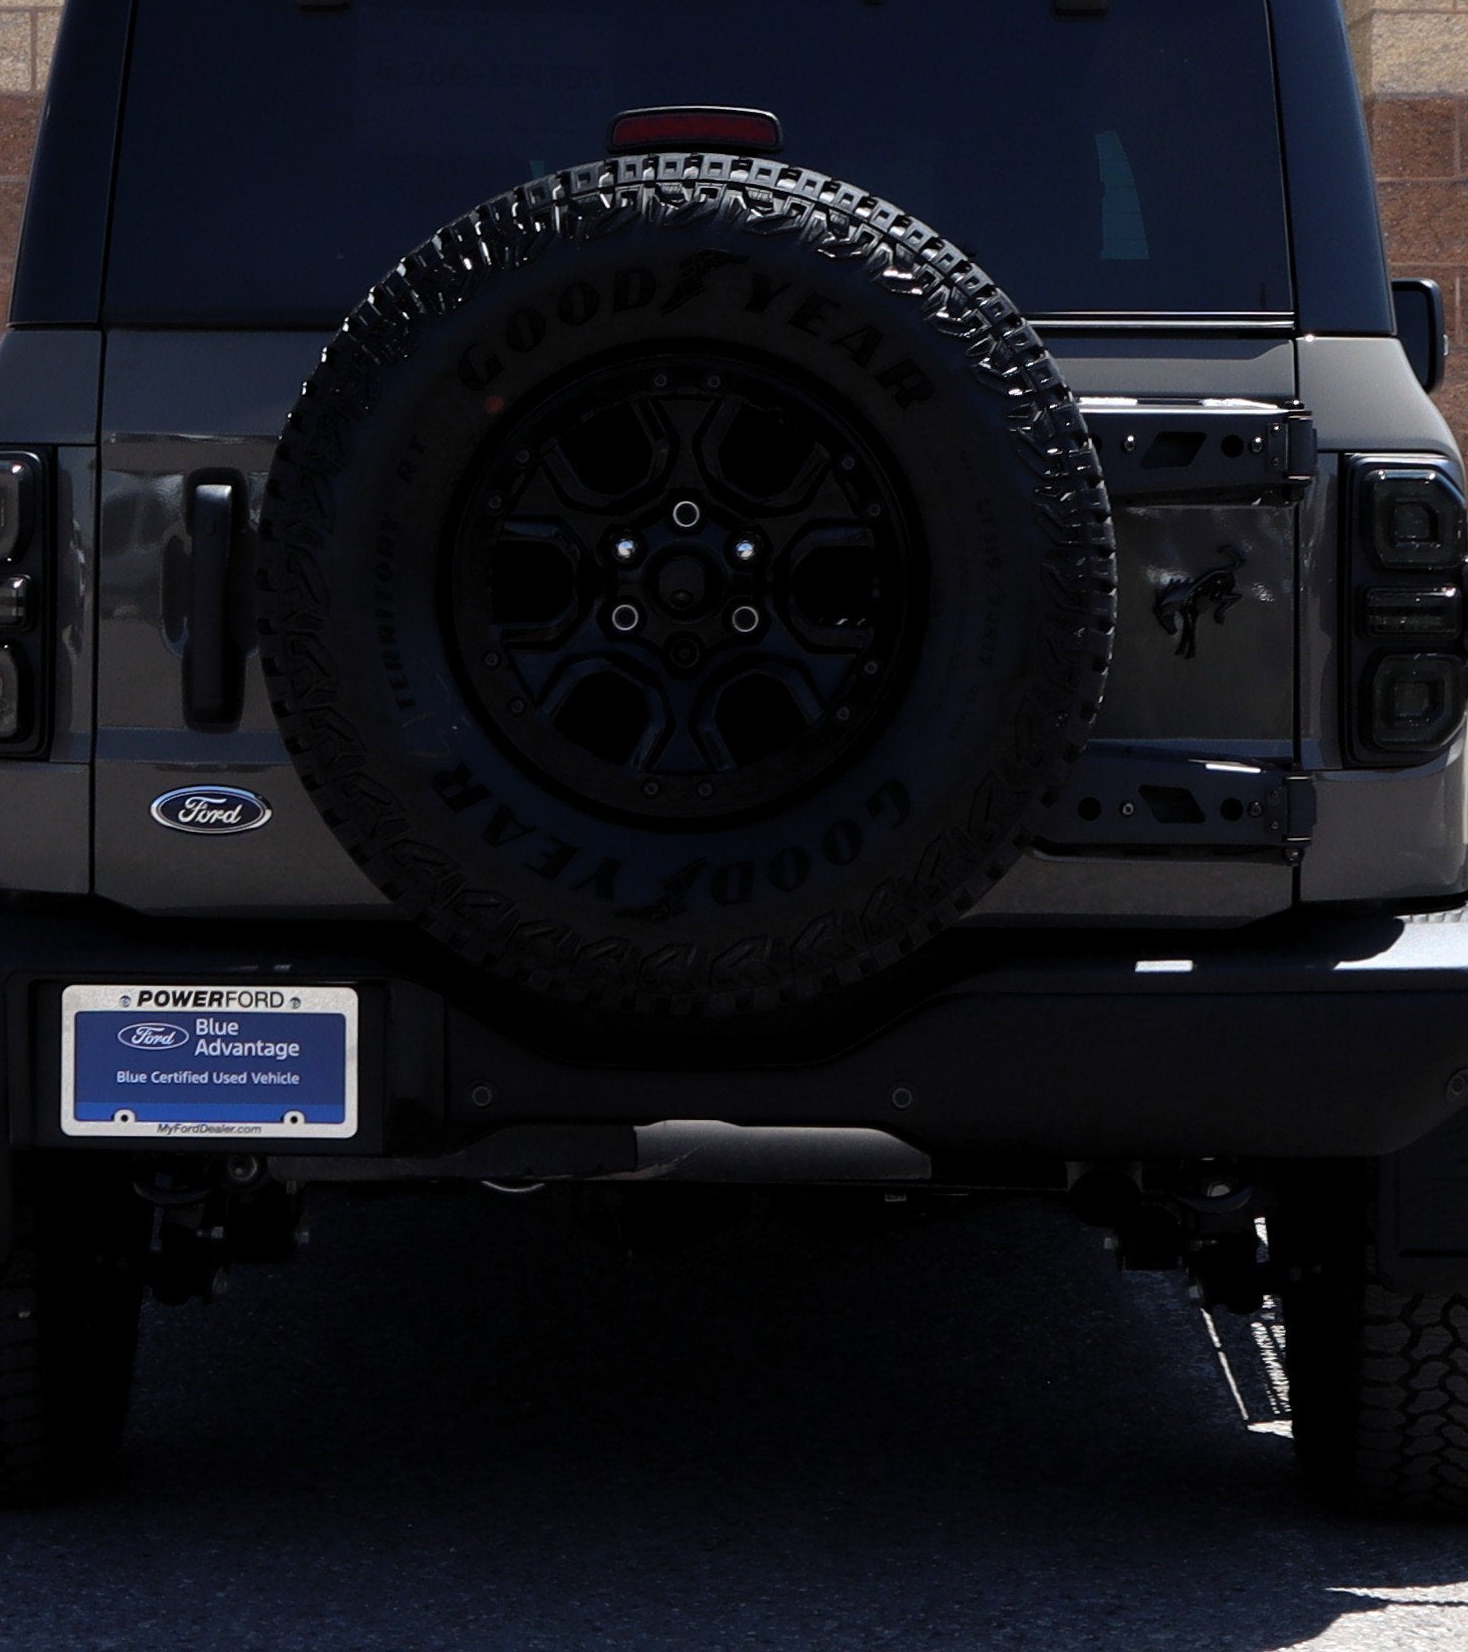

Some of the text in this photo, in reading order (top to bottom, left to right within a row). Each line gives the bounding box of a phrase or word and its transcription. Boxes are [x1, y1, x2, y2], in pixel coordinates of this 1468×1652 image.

[177, 795, 243, 825] Ford
[136, 989, 285, 1009] POWERFORD
[131, 1025, 177, 1046] Ford
[195, 1017, 240, 1036] Blue
[194, 1038, 300, 1061] Advantage
[116, 1071, 300, 1086] Blue Certified Used Vehicle
[156, 1123, 262, 1136] MyFordDealer.com
